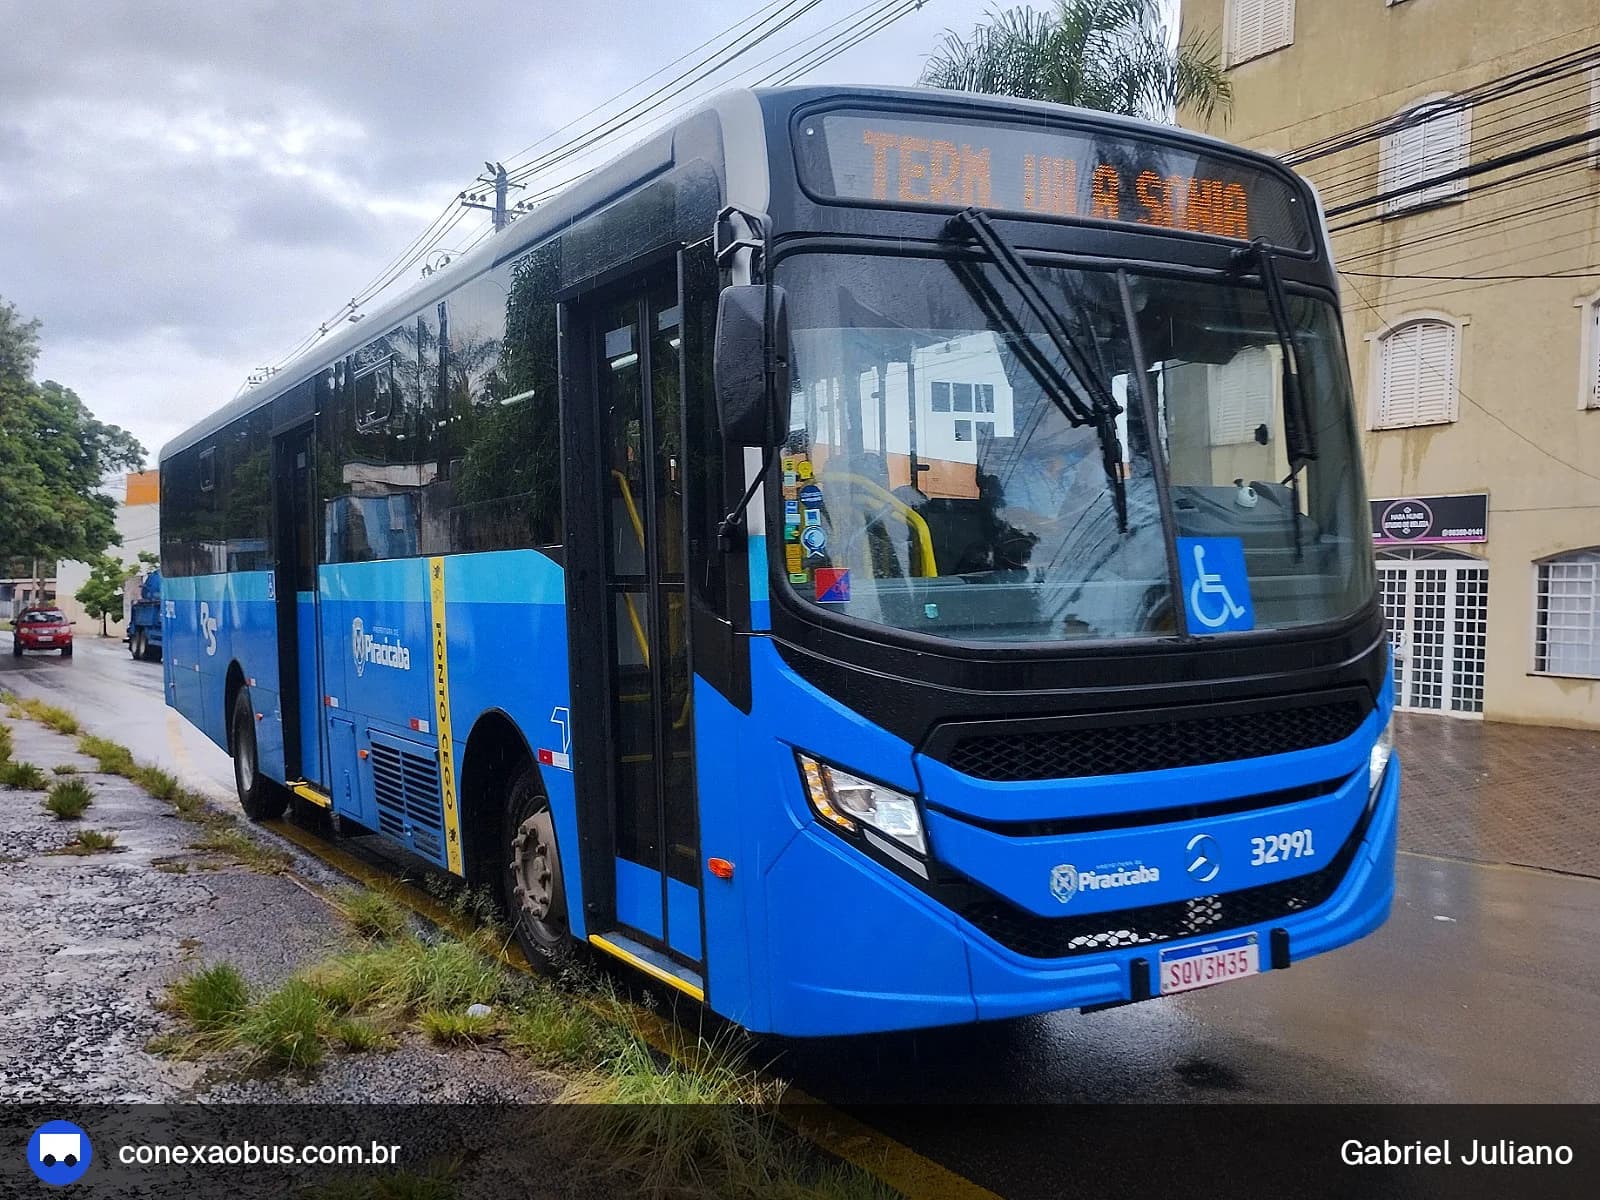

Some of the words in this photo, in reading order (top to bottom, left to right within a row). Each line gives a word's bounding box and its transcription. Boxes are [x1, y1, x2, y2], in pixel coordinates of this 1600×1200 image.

[363, 634, 411, 670] Piracicaba
[436, 622, 446, 722] PONTO
[442, 733, 453, 810] CEGO
[1251, 829, 1315, 866] 32991
[1078, 865, 1159, 891] Piracicaba
[1170, 950, 1248, 987] SQV3H35
